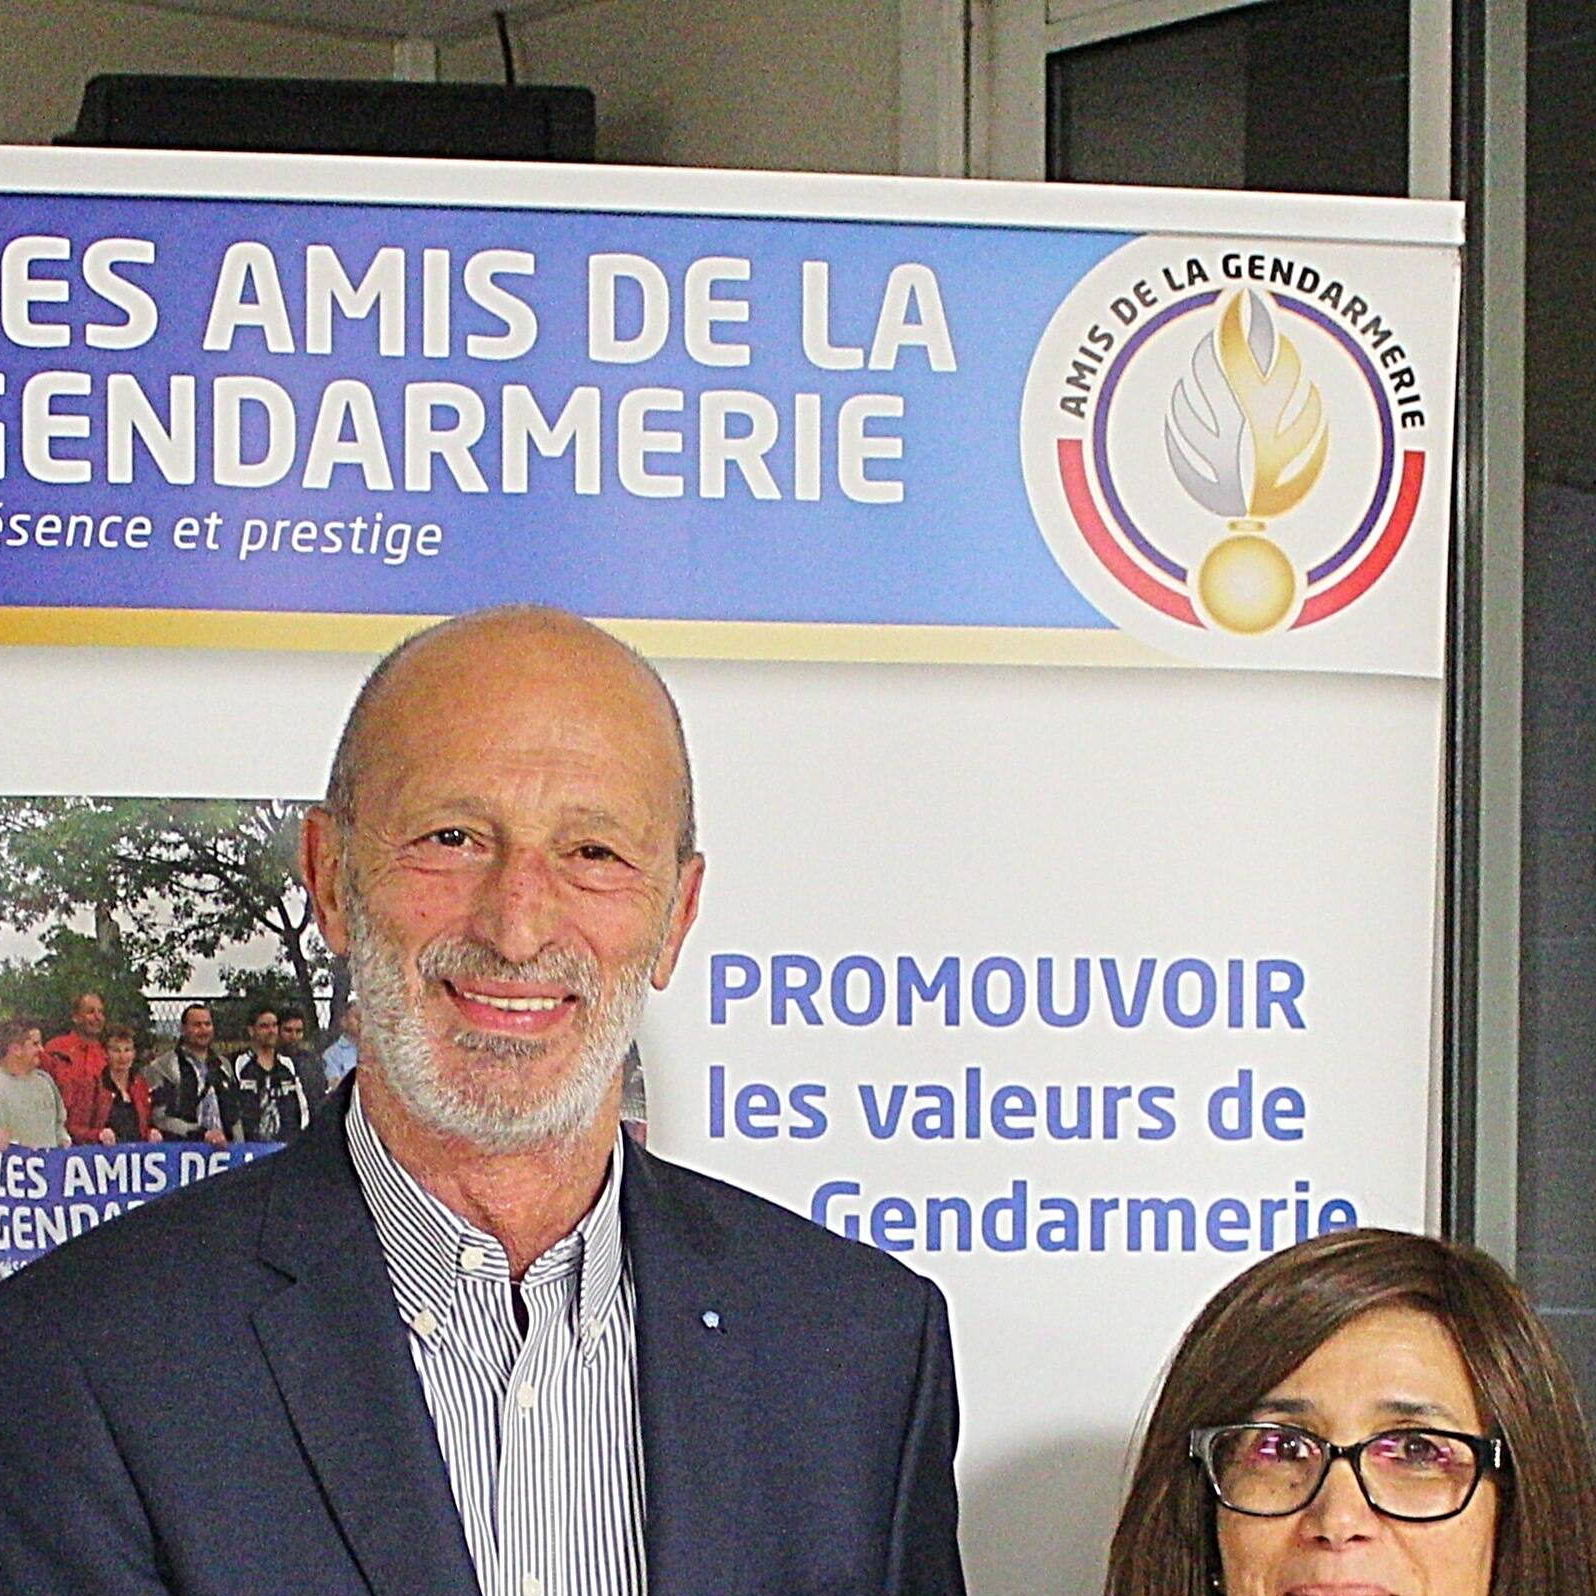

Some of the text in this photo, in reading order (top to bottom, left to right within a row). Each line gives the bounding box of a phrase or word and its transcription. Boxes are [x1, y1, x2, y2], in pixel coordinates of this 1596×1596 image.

[203, 242, 538, 363] AMIS
[589, 252, 753, 367] DE
[798, 260, 957, 374] LA
[1059, 252, 1425, 430] AMIS DE LA GENDARMERIE
[170, 513, 224, 553] et
[238, 512, 444, 566] prestige
[708, 953, 1307, 1031] PROMOUVOIR
[707, 1065, 1306, 1141] les valeurs de
[63, 1151, 167, 1198] AMIS
